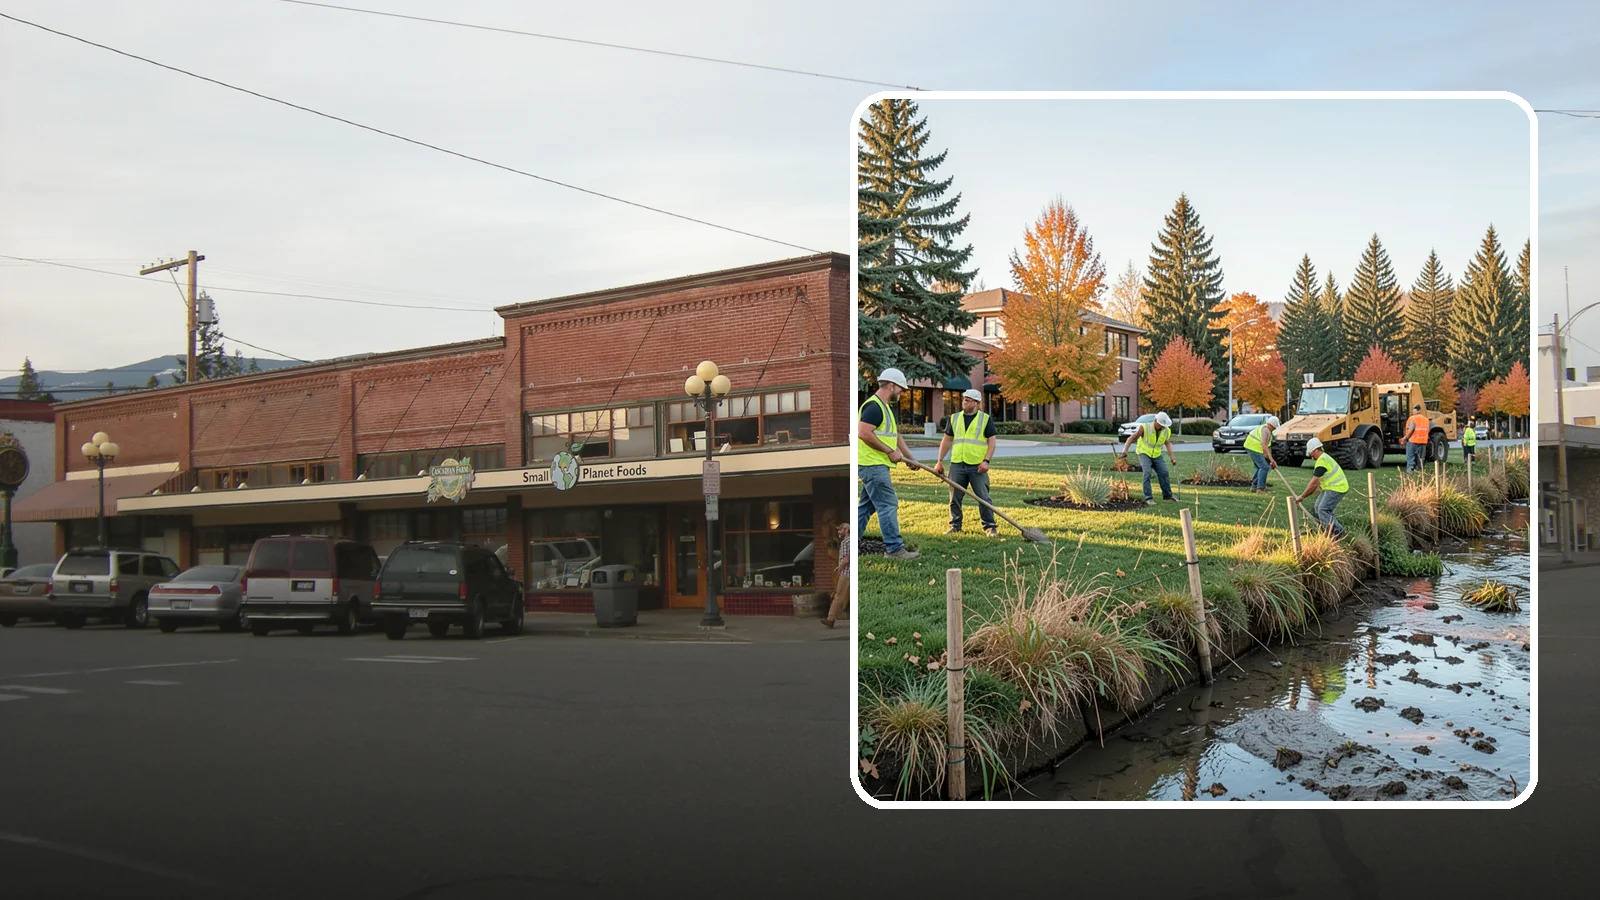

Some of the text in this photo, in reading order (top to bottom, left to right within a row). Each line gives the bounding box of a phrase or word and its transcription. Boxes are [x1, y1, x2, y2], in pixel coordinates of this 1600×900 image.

[523, 464, 647, 483] Small Planet Foods
